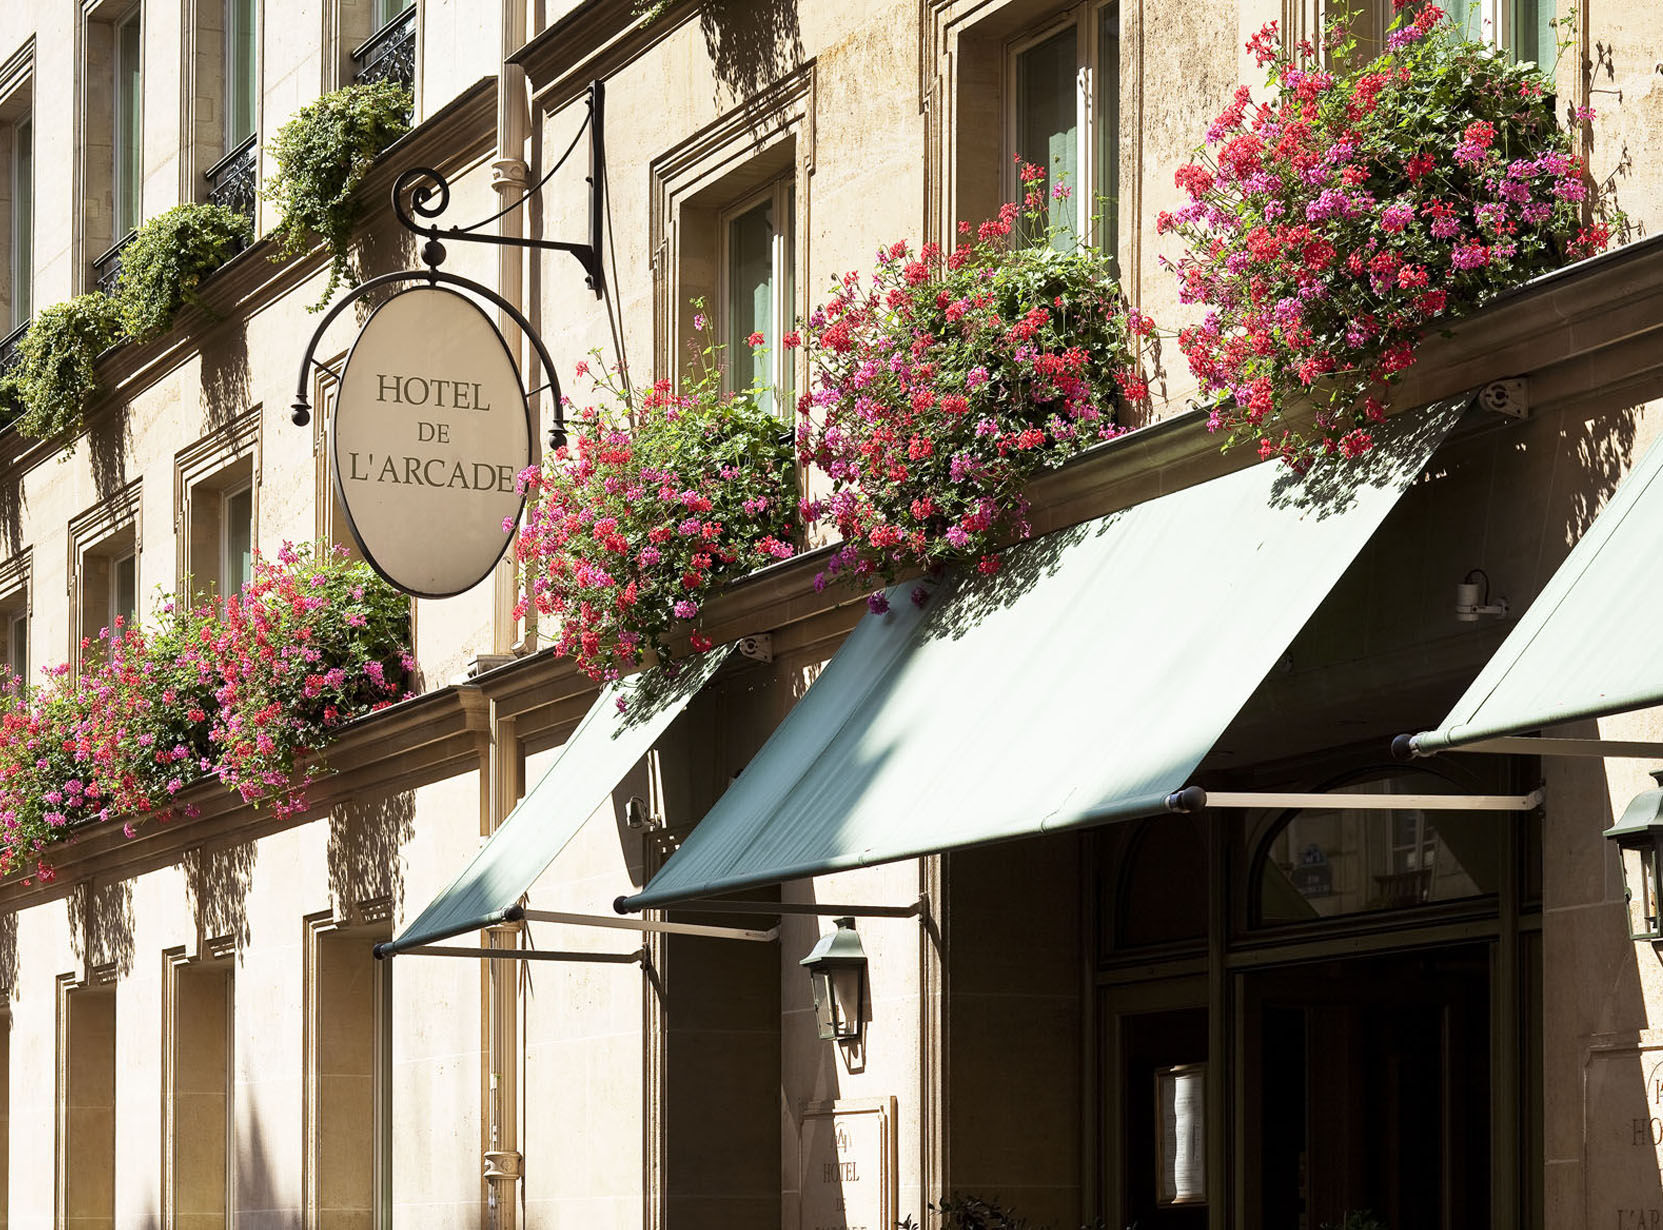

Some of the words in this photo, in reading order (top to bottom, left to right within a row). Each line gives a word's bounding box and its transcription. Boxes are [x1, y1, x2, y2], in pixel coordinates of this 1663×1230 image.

[376, 374, 491, 411] HOTEL
[417, 421, 450, 444] DE
[348, 452, 515, 493] L'ARCADE
[823, 1162, 860, 1183] HOTEL
